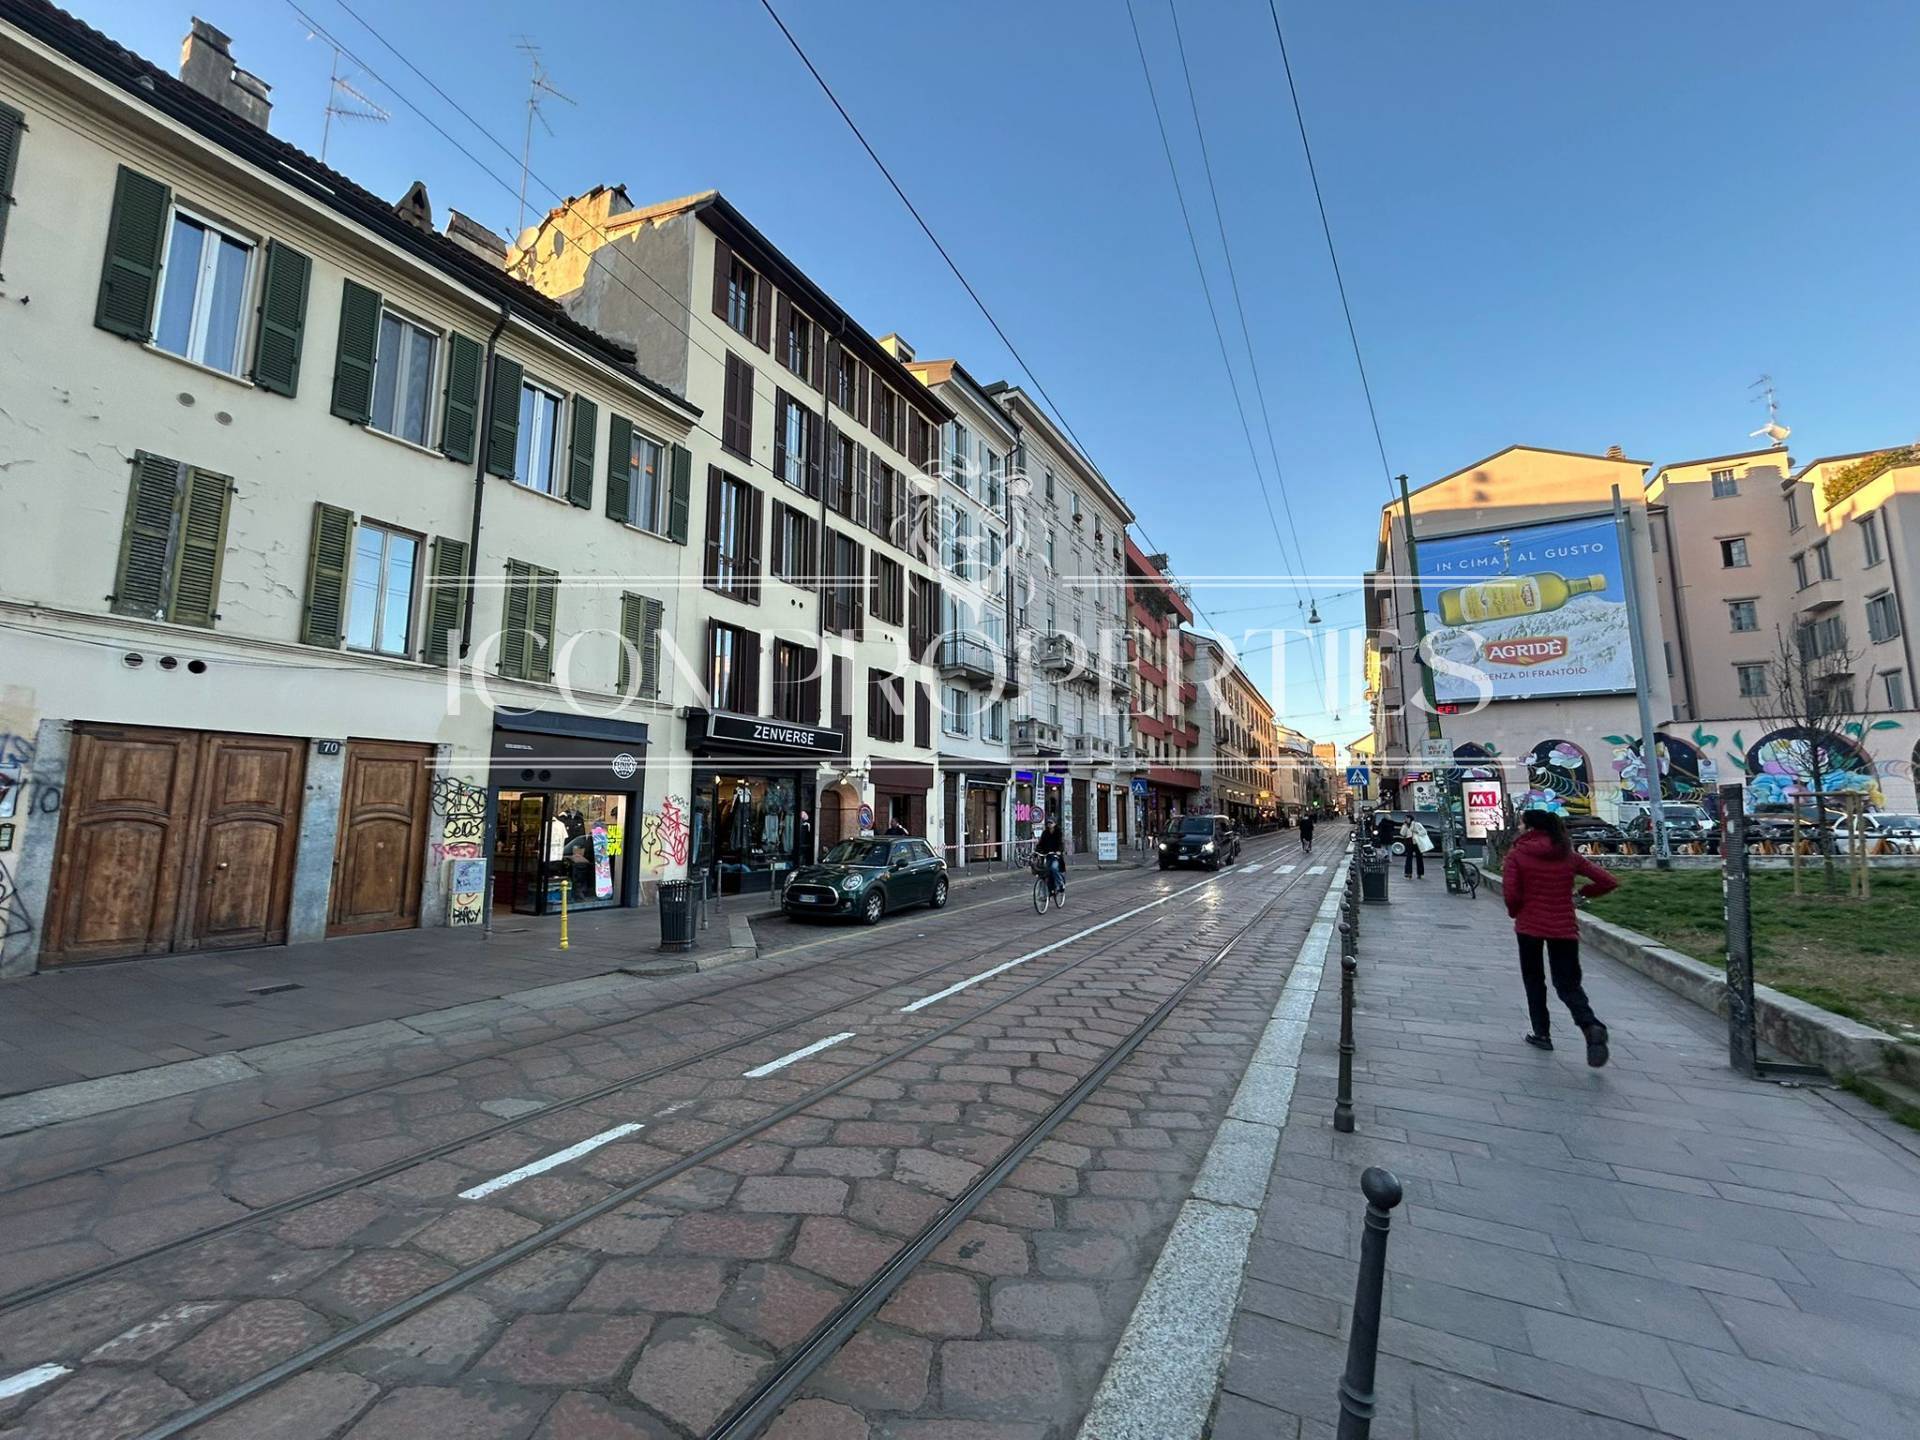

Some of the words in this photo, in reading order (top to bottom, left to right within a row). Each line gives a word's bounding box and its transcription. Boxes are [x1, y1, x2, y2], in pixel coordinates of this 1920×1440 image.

[1436, 562, 1452, 571] IN
[1459, 557, 1500, 569] CIMA
[1518, 553, 1537, 562] AL
[1545, 542, 1604, 559] GUSTO
[1519, 671, 1529, 679] DI
[753, 725, 815, 745] ZENVERSE
[323, 742, 338, 753] 70
[1471, 794, 1493, 805] M1
